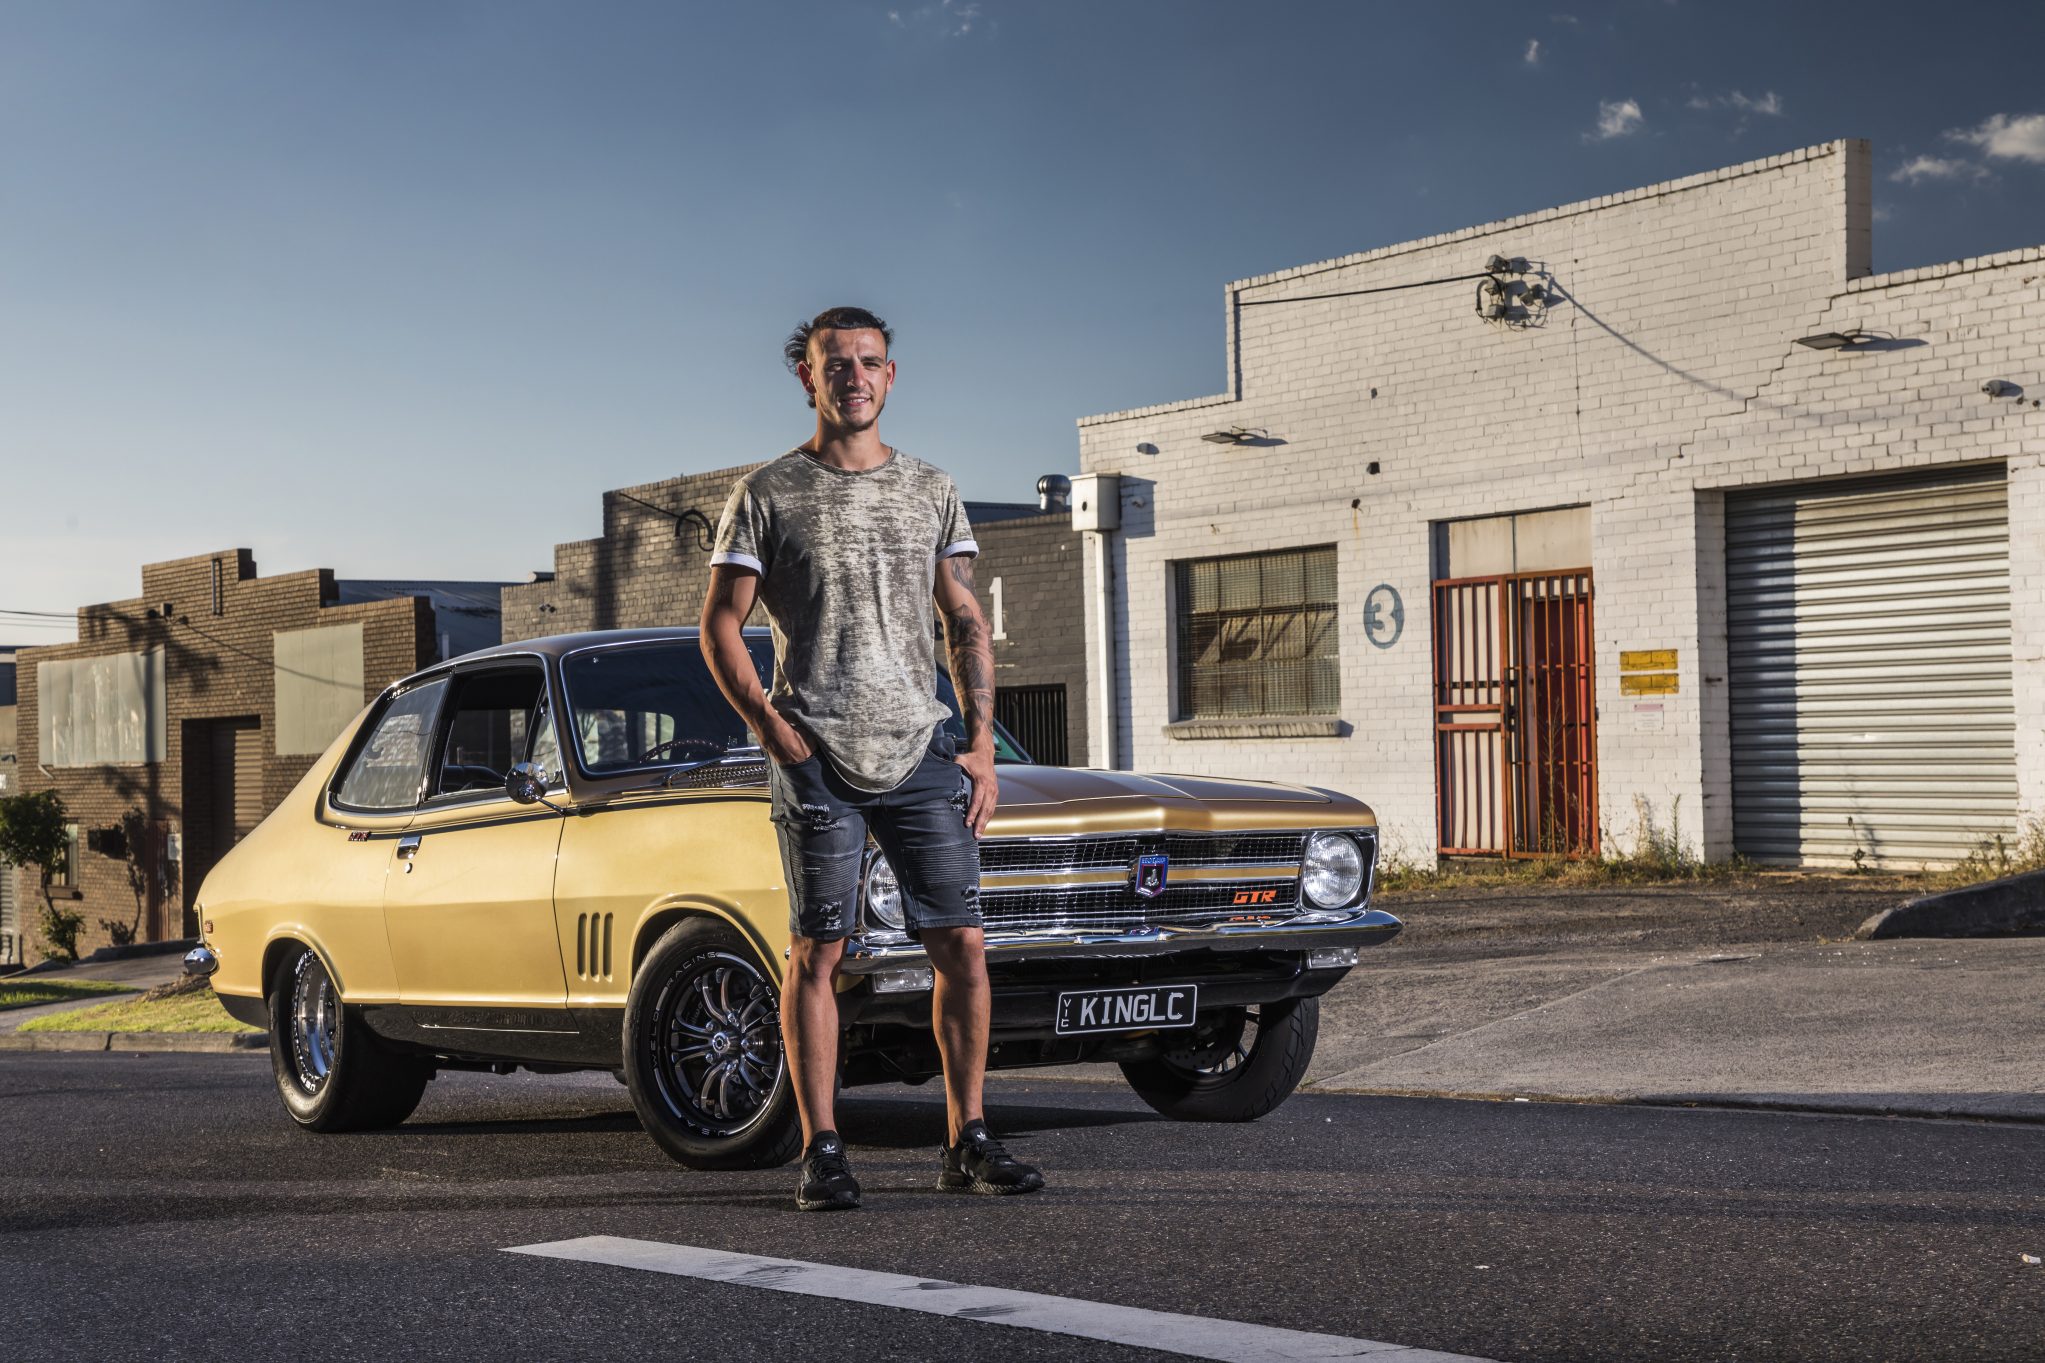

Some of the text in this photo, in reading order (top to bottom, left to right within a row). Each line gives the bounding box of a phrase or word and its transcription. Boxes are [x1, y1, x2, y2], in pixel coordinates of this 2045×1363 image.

[988, 576, 1007, 640] 1
[1369, 587, 1398, 645] 3
[1233, 890, 1277, 904] GTR
[651, 951, 717, 1068] WELD RACING
[1061, 999, 1072, 1027] VIC
[1080, 992, 1185, 1026] KINGLC
